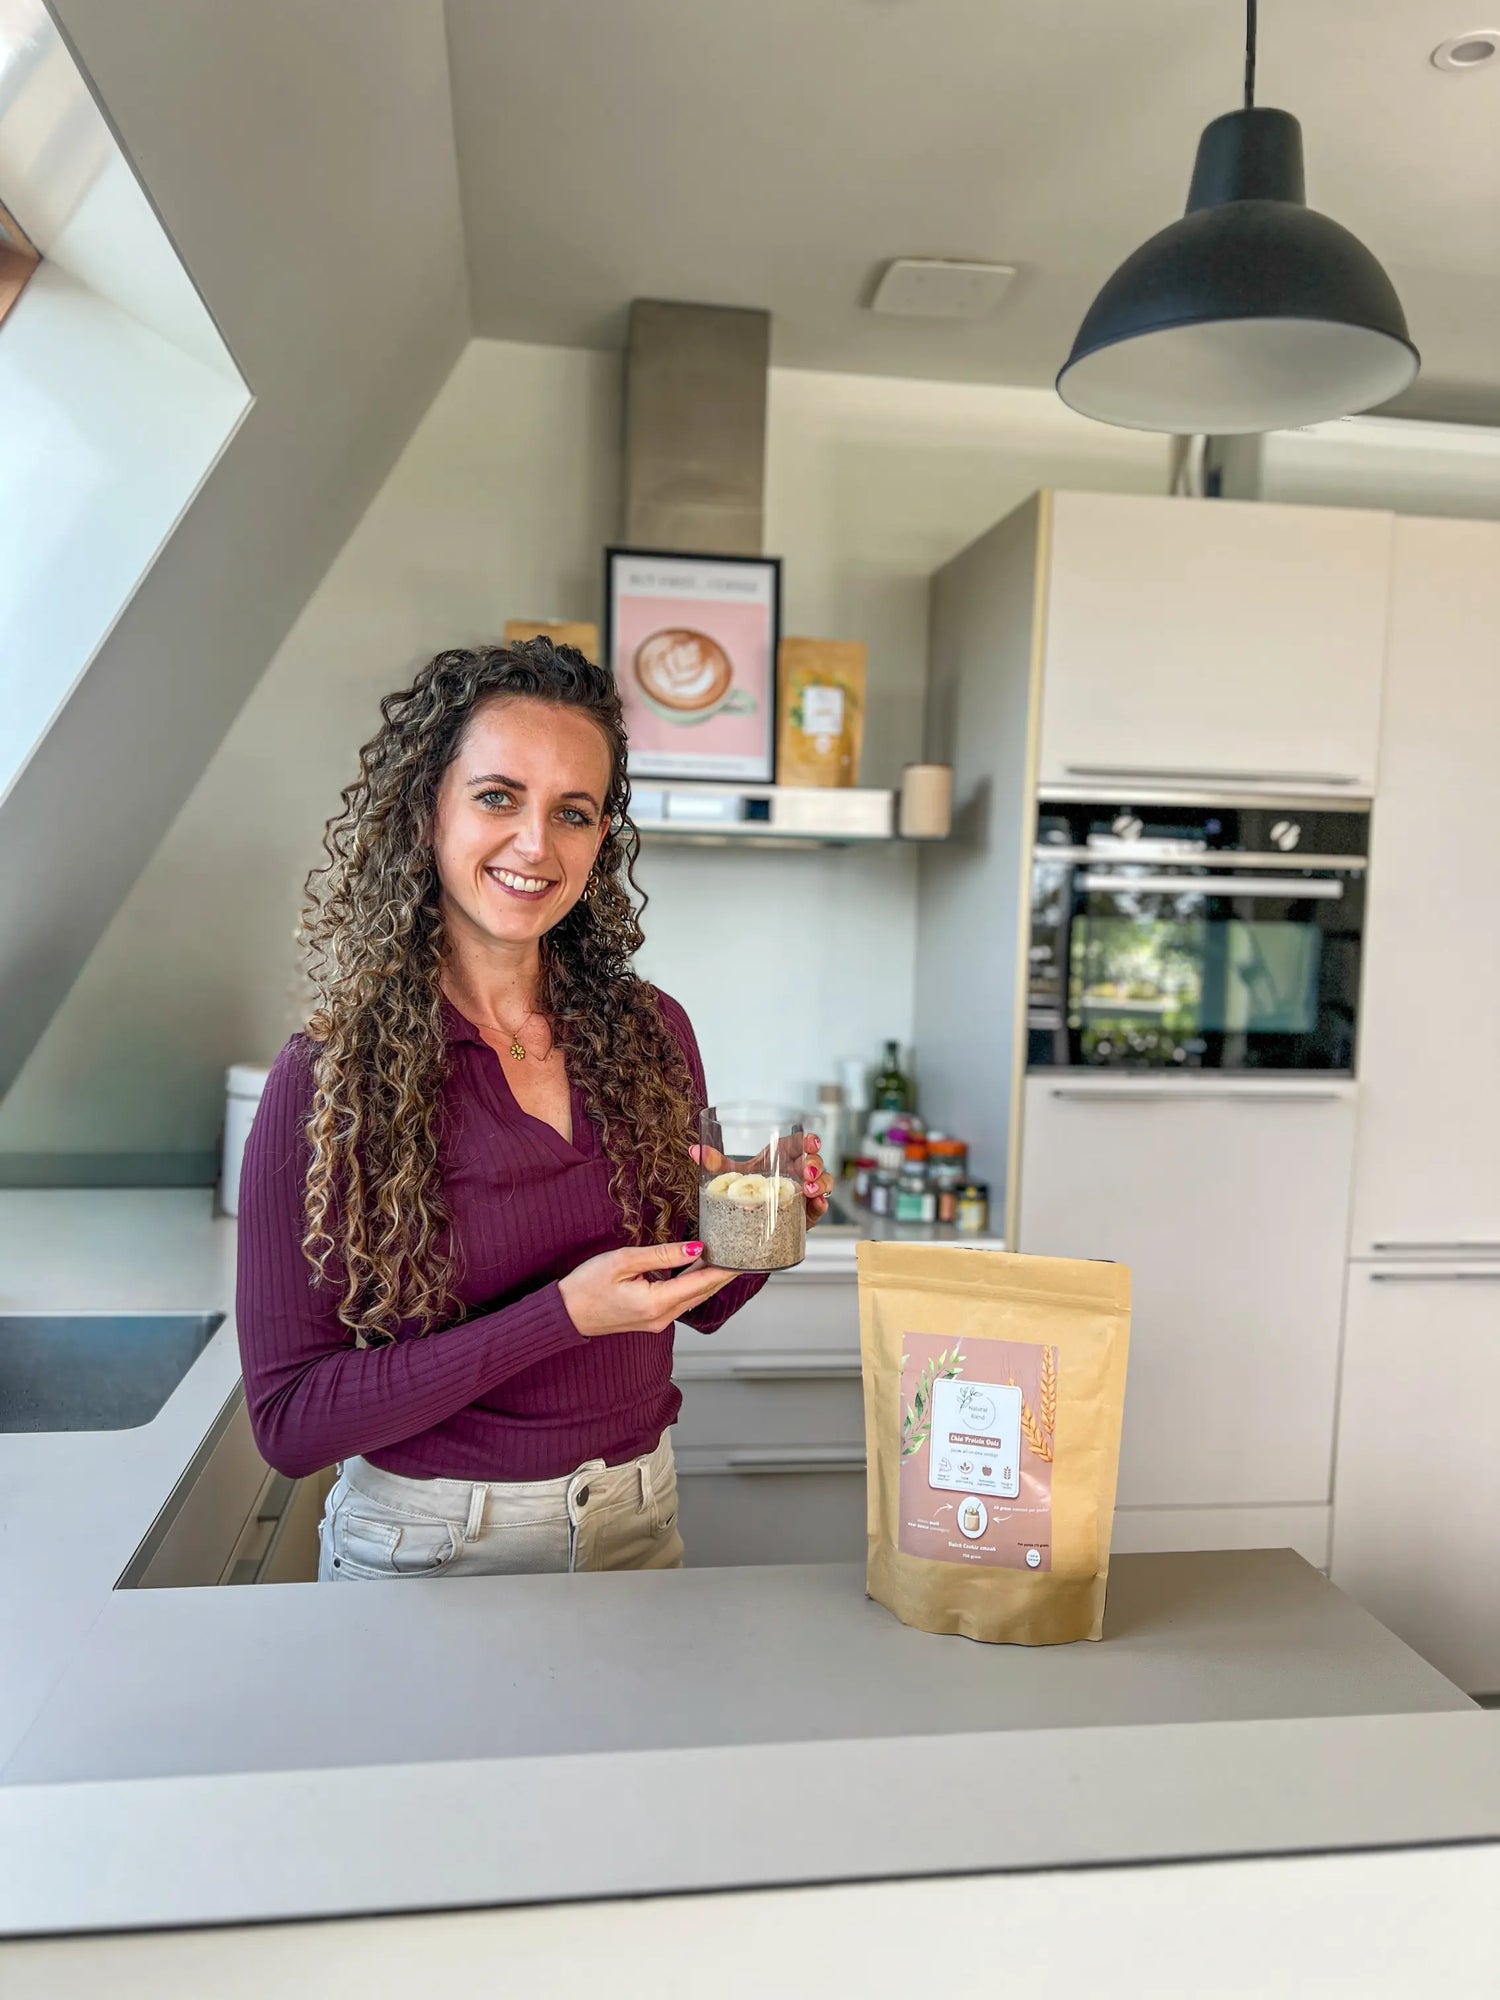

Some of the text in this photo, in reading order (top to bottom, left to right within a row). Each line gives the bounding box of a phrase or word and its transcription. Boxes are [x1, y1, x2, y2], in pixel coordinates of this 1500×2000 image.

[969, 1404, 988, 1413] Natural
[950, 1434, 999, 1447] Chia Protein Oats
